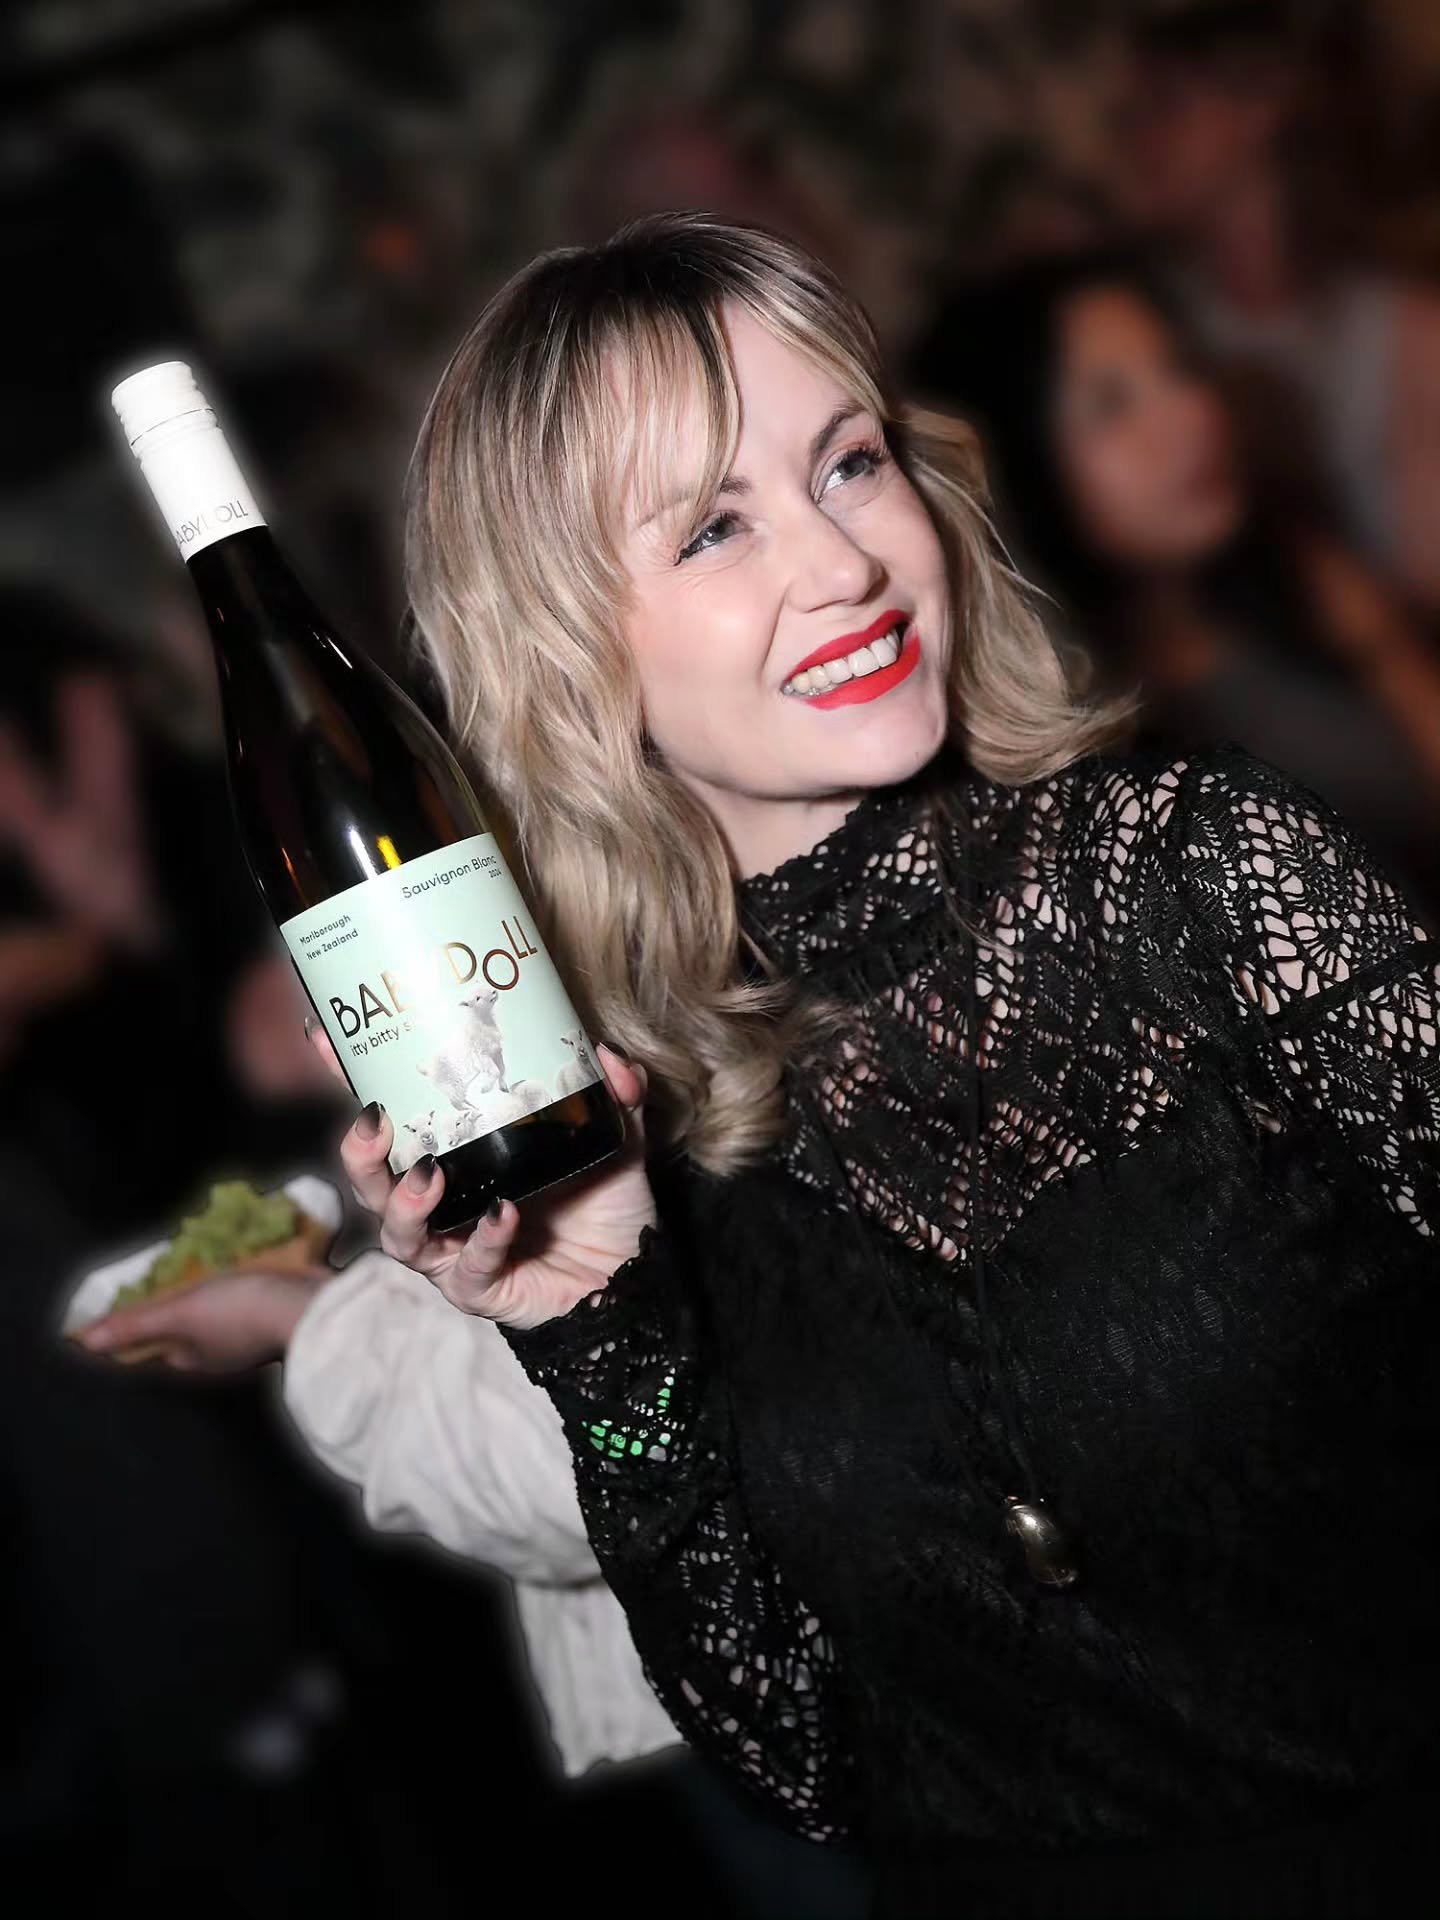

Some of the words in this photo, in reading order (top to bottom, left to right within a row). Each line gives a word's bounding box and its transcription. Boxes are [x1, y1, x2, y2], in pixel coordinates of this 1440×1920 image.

[401, 863, 471, 899] Sauvignon
[471, 856, 497, 871] Blanc
[299, 914, 351, 946] Marlborough
[306, 949, 321, 961] New
[321, 928, 358, 952] Zealand
[350, 1042, 368, 1057] itty
[368, 1026, 399, 1048] bitty
